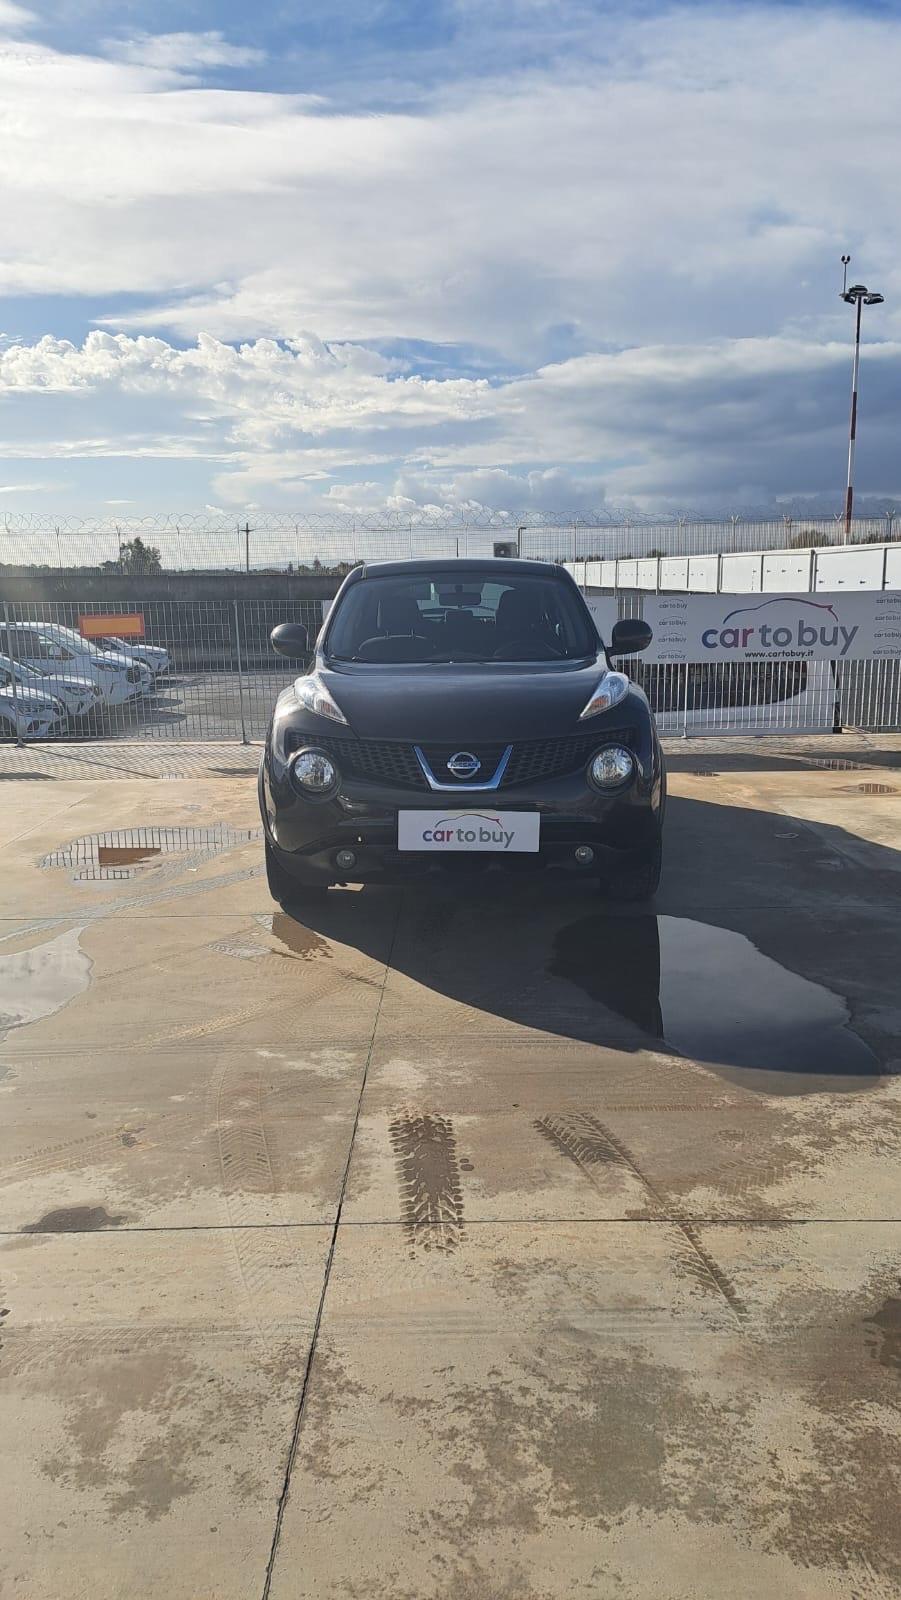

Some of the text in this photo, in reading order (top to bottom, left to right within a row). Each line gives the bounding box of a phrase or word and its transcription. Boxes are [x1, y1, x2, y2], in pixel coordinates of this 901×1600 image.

[701, 620, 859, 656] car to buy
[744, 650, 815, 658] www.cartobuy.it
[422, 827, 515, 849] car to buy
